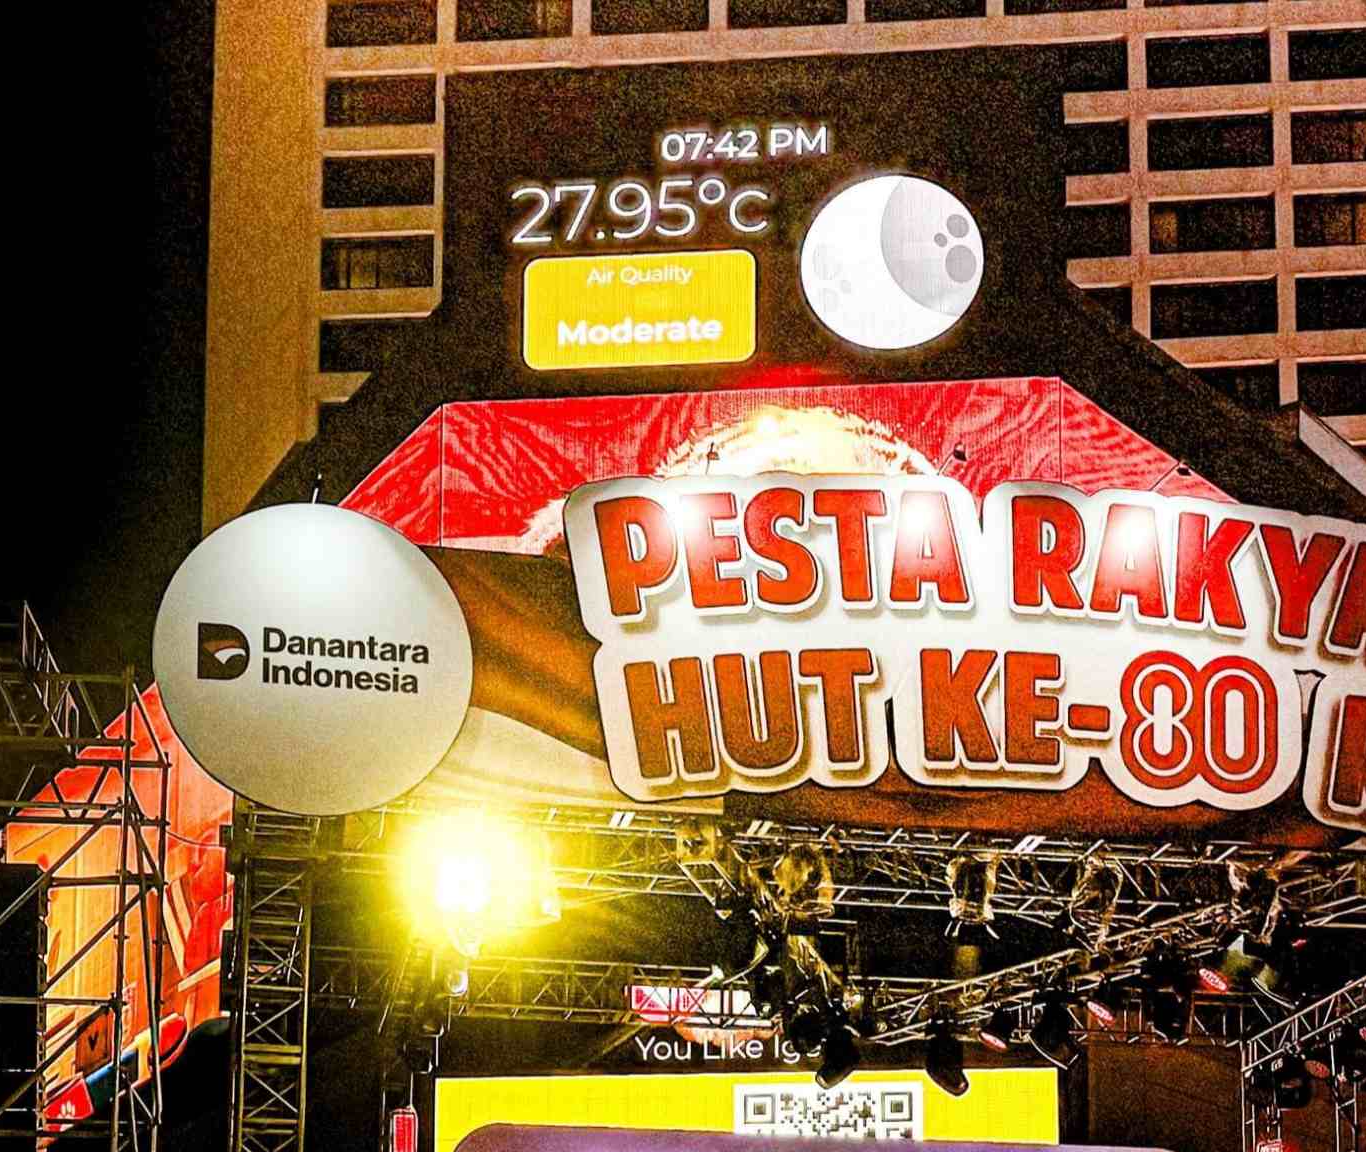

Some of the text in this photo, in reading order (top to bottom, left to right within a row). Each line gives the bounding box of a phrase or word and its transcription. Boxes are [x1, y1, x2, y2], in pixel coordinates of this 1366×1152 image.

[661, 126, 828, 162] 07:42 PM
[587, 264, 693, 287] Air Quality
[557, 315, 724, 347] Moderate
[594, 487, 969, 616] PESTA
[262, 626, 430, 665] Danantara
[262, 656, 419, 695] Indonesia
[625, 649, 871, 778] HUT
[920, 649, 1278, 794] KE-80
[635, 1036, 692, 1060] You
[703, 1034, 764, 1060] Like
